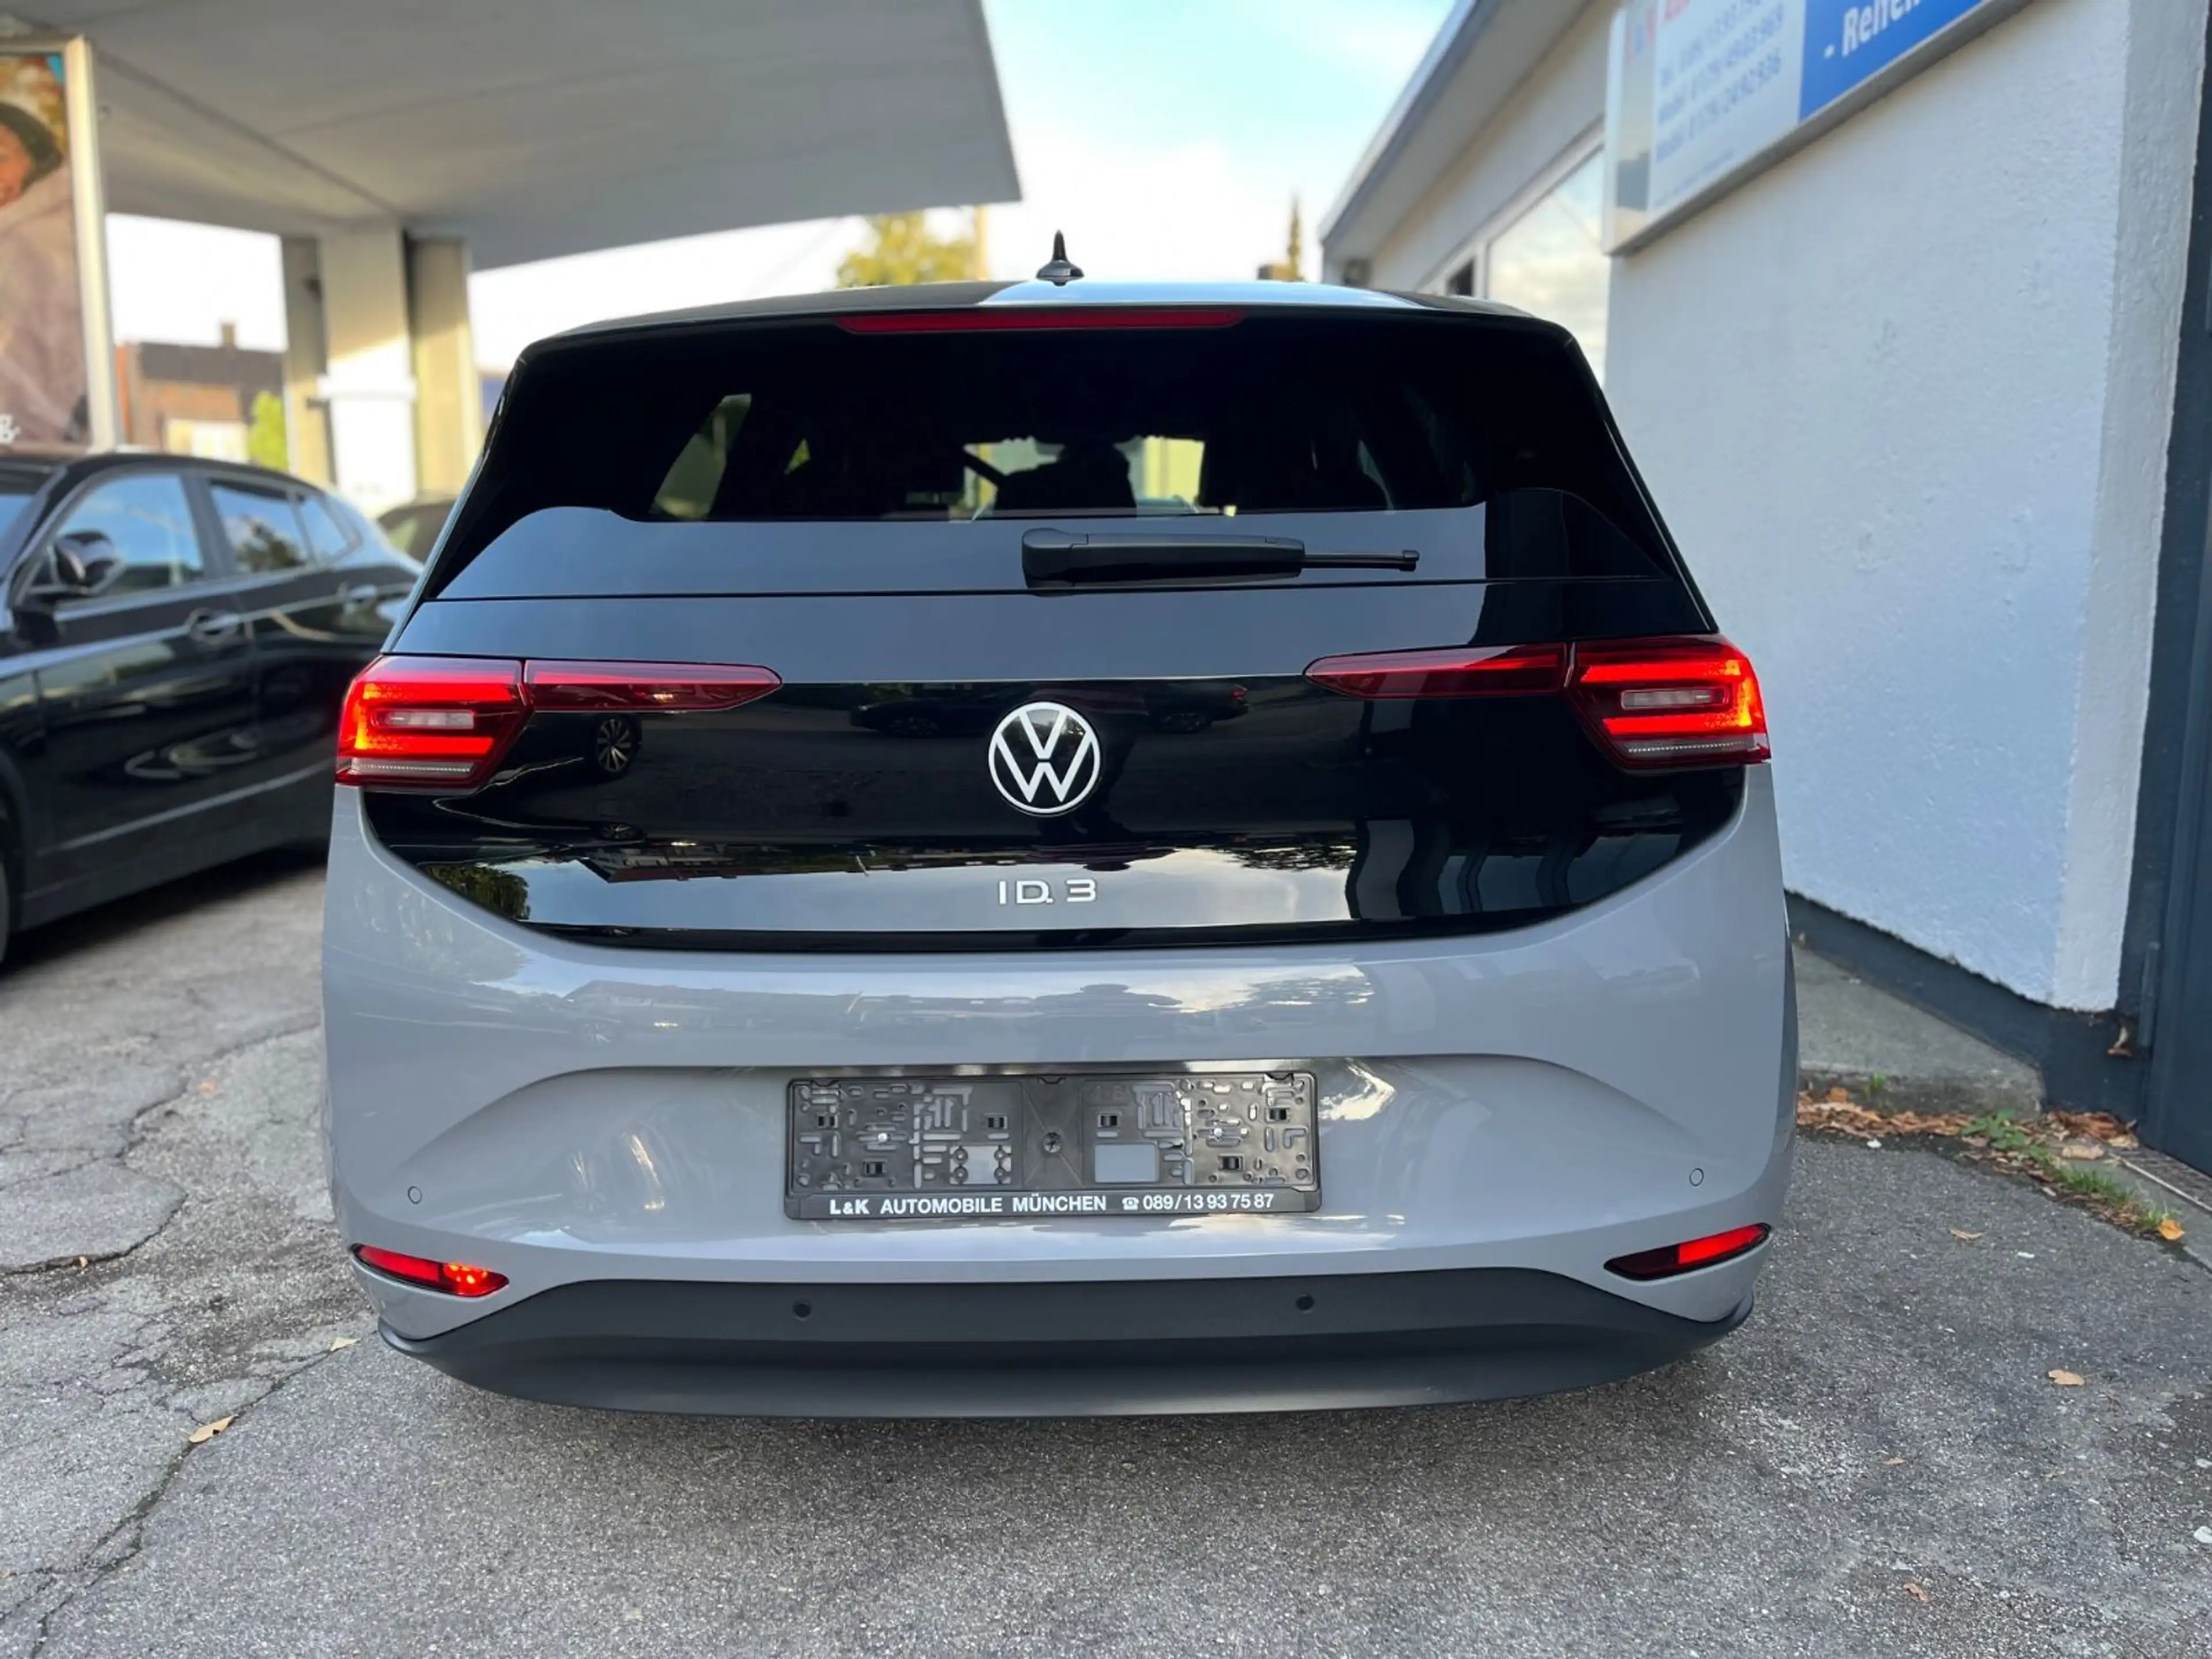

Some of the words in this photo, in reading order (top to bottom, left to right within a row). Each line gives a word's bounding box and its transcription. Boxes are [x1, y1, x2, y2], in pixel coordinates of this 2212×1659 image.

[830, 1199, 869, 1215] L&K
[880, 1197, 1003, 1214] AUTOMOBILE
[1013, 1192, 1107, 1212] MÜNCHEN
